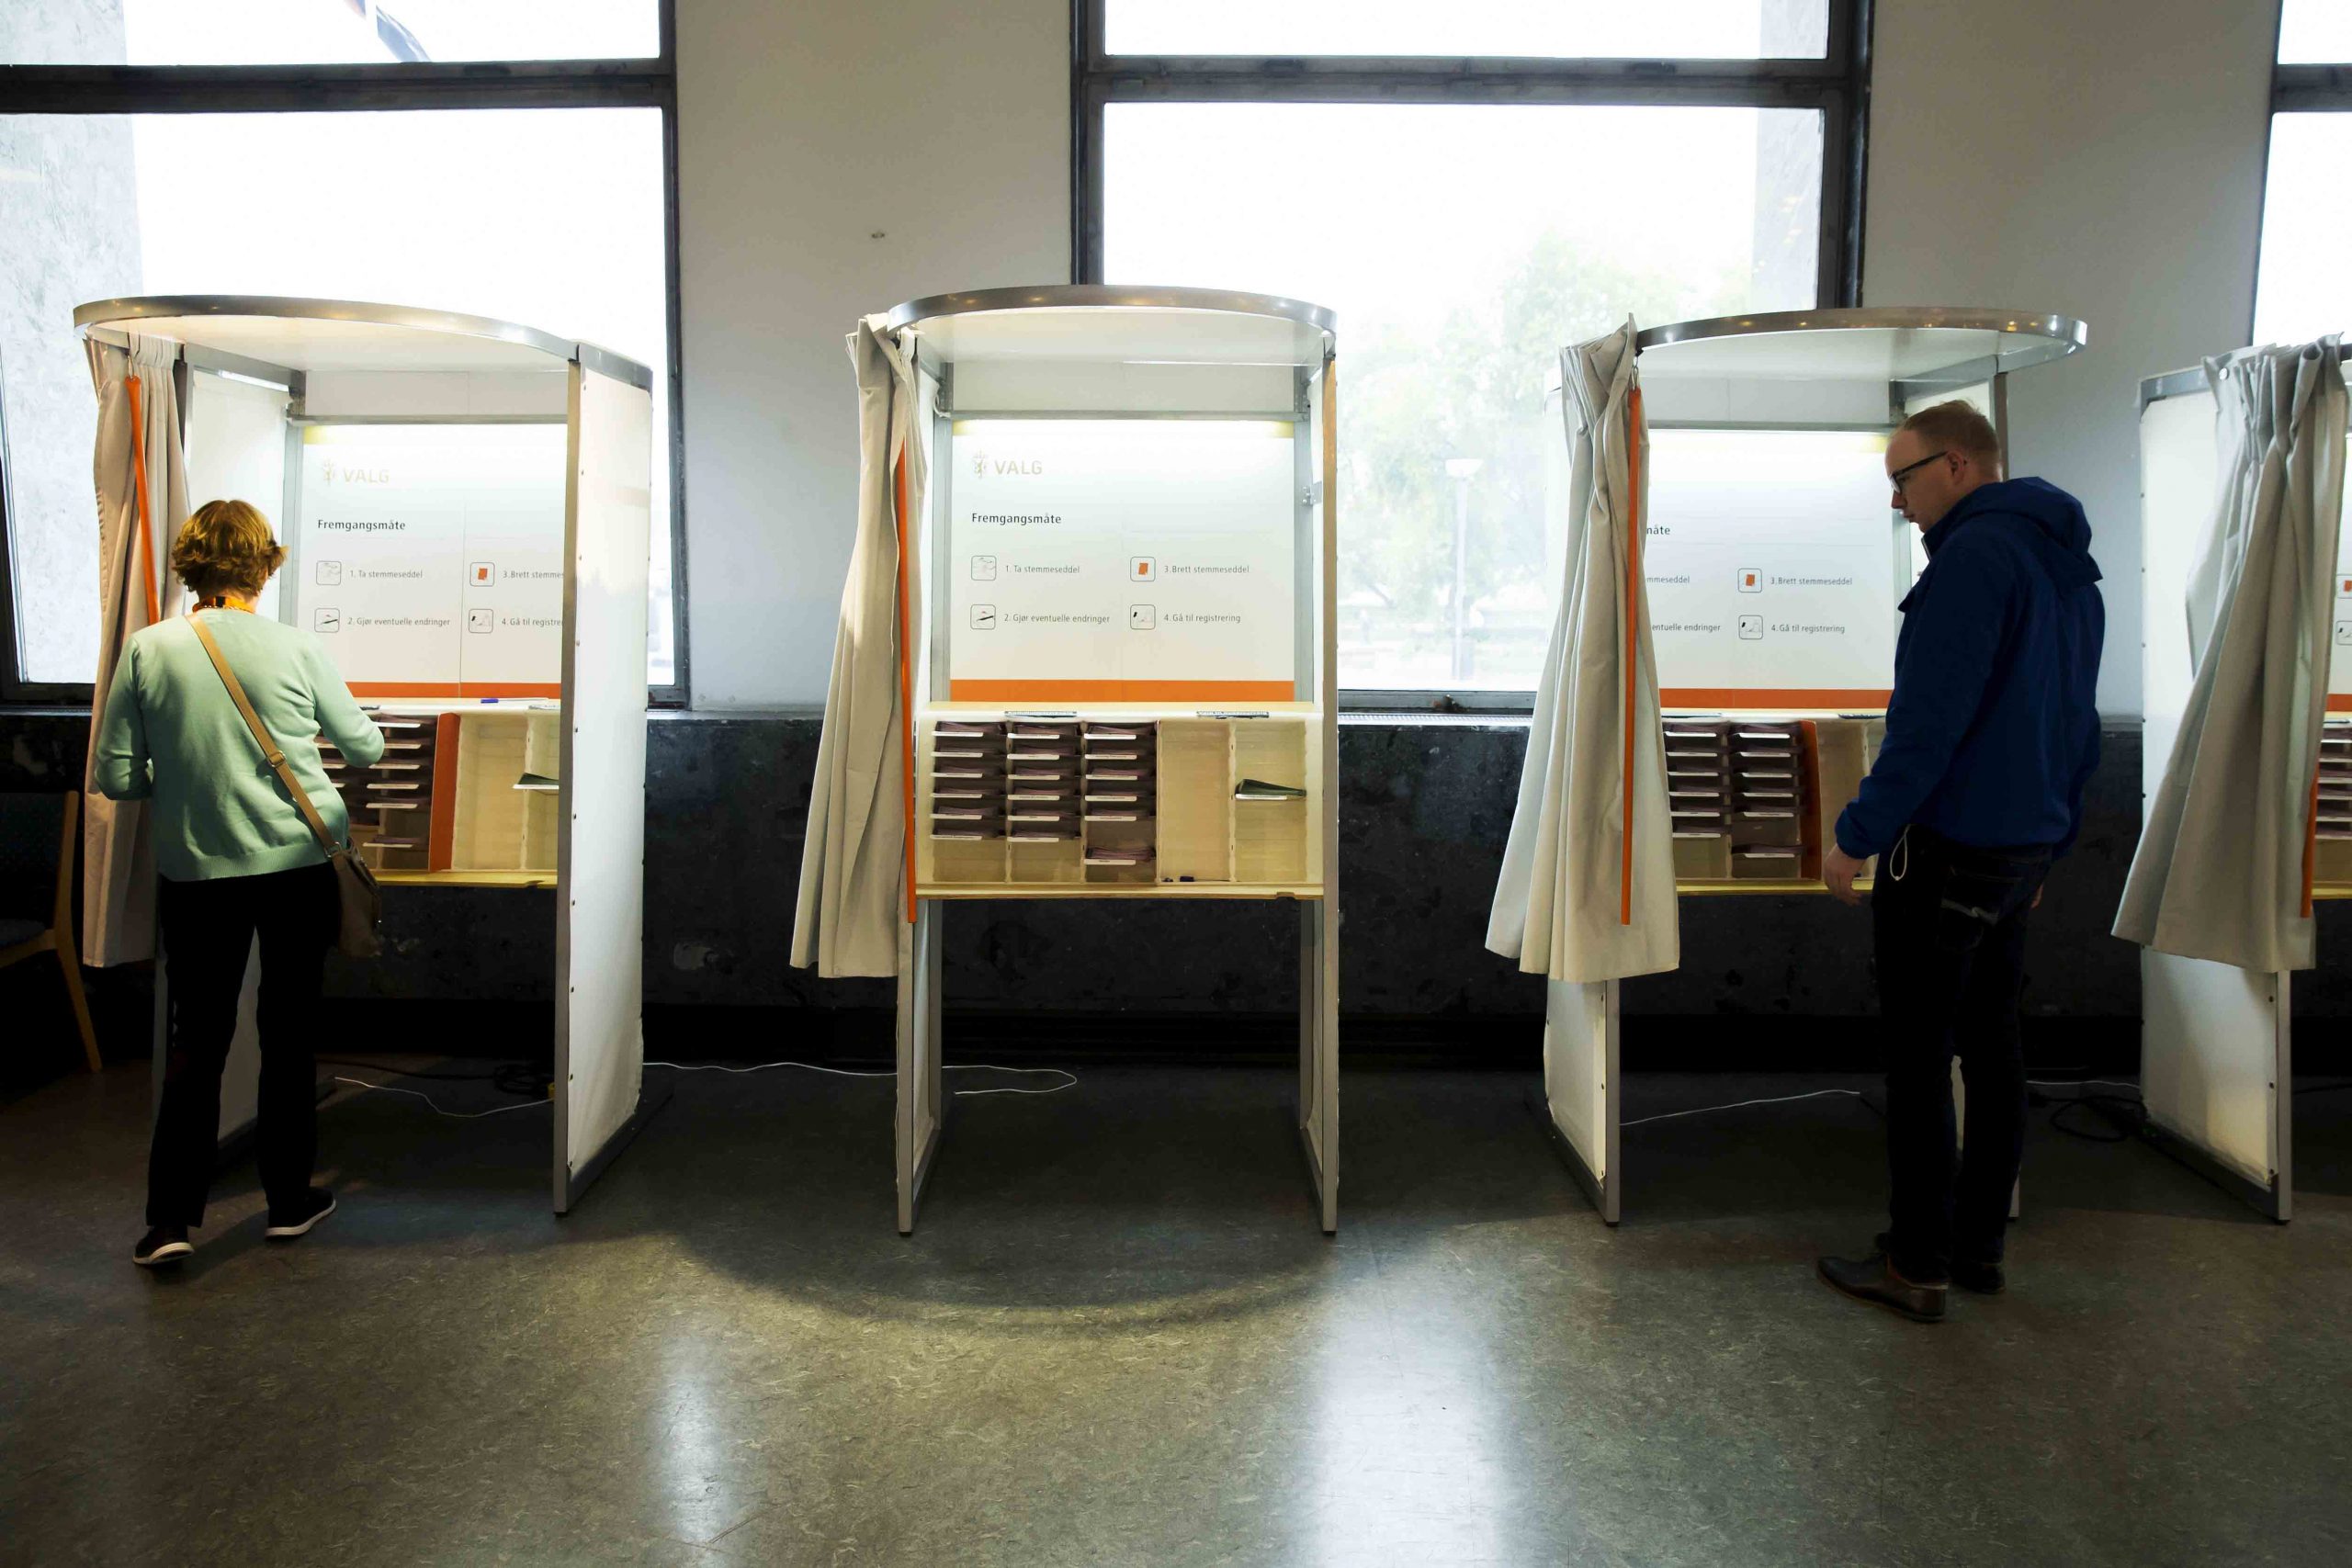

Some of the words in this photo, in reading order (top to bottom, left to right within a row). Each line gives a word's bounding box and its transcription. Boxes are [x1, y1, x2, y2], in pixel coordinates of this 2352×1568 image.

[994, 459, 1042, 475] VALG
[343, 468, 390, 483] VALG
[972, 512, 1061, 525] Fremgangsmåte
[317, 519, 406, 532] Fremgangsmåte
[1013, 565, 1022, 573] Ta
[1023, 565, 1080, 574] stemmeseddel
[1193, 565, 1250, 574] stemmeseddel
[358, 570, 367, 579] Ta
[368, 570, 423, 579] stemmeseddel
[531, 570, 564, 579] stemmes
[1646, 575, 1690, 584] mmeseddel
[1799, 577, 1852, 585] stemmeseddel
[356, 617, 372, 626] Gjør
[374, 617, 413, 626] eventuelle
[414, 617, 450, 627] endringer
[532, 618, 562, 628] registre
[1012, 614, 1028, 624] Gjør
[1031, 614, 1070, 623] eventuelle
[1072, 615, 1110, 625] endringer
[1195, 614, 1241, 624] registrering
[1652, 624, 1682, 632] entuelle
[1683, 624, 1721, 633] endringer
[1801, 625, 1845, 634] registrering
